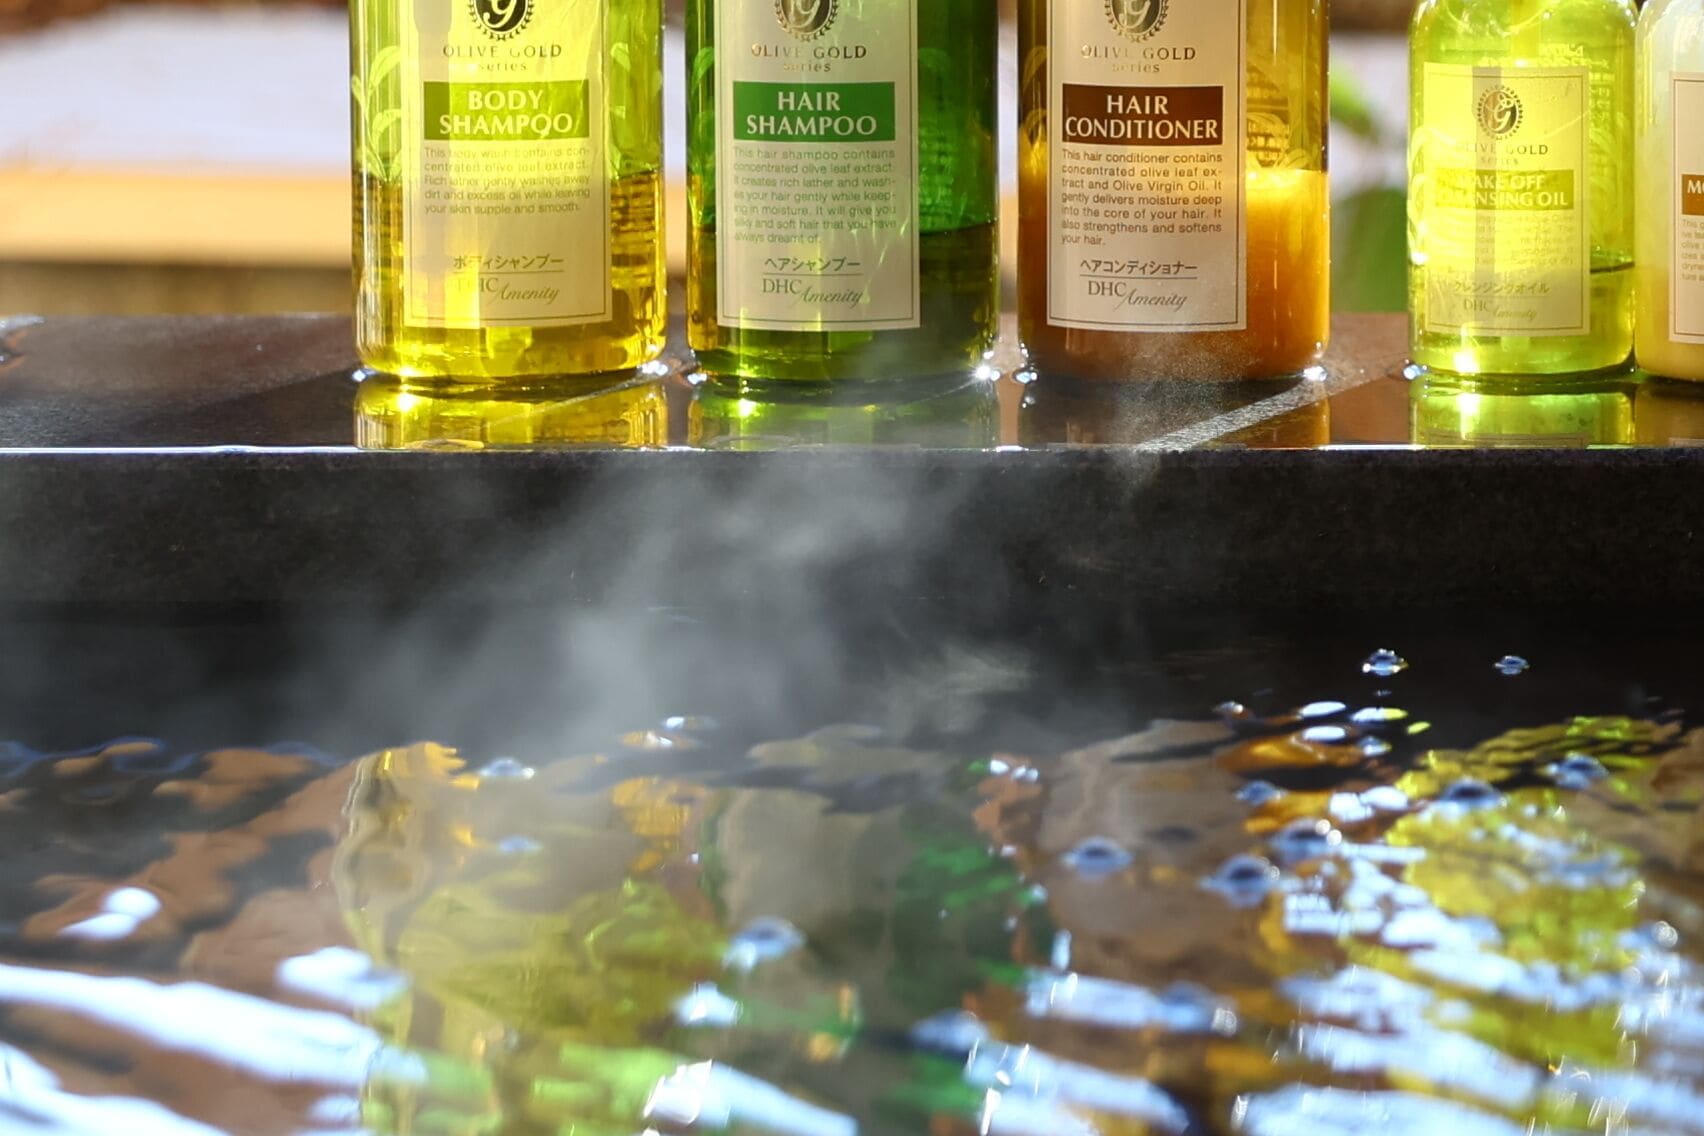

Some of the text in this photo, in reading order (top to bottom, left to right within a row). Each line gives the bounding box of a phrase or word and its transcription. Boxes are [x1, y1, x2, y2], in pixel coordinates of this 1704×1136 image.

[443, 44, 561, 57] OLIVE GOLD
[751, 44, 867, 59] OLIVE GOLD
[1143, 47, 1196, 60] GOLD
[783, 63, 831, 72] series
[468, 89, 544, 110] BODY
[778, 91, 841, 112] HAIR
[1107, 94, 1168, 115] HAIR
[439, 113, 573, 135] SHAMPOO
[746, 115, 877, 136] SHAMPOO
[1065, 116, 1218, 140] CONDITIONER
[734, 146, 896, 162] This hair shampoo contains
[1062, 148, 1222, 164] This hair conditioner contains
[734, 163, 851, 174] concentrated olive leaf
[1061, 164, 1222, 177] concentrated olive leaf ex-
[780, 178, 799, 188] rich
[803, 178, 833, 188] lather
[838, 178, 859, 188] and
[862, 177, 896, 188] wash-
[1061, 177, 1222, 193] tract and Olive Virgin Oil. It
[1510, 174, 1546, 190] OFF
[467, 192, 506, 201] excess
[746, 191, 767, 202] your
[771, 191, 790, 200] hair
[794, 191, 828, 204] gently
[832, 191, 861, 201] while
[1061, 192, 1222, 206] gently delivers moisture deep
[1537, 192, 1568, 207] OIL
[449, 204, 471, 214] skin
[474, 204, 511, 216] supple
[514, 203, 535, 213] and
[828, 206, 846, 215] will
[849, 206, 873, 218] give
[875, 206, 896, 217] you
[1062, 206, 1222, 221] into the core of your hair. It
[755, 219, 774, 229] and
[777, 219, 796, 229] soft
[800, 219, 819, 229] hair
[823, 219, 844, 229] that
[847, 220, 868, 231] you
[1062, 220, 1222, 234] also strengthens and softens
[767, 232, 804, 244] dreamt
[1061, 234, 1106, 246] your hair.
[1080, 259, 1199, 275] ヘアコンディショナー
[493, 282, 560, 305] Amenity
[762, 278, 864, 309] DHC Amenity
[1087, 280, 1188, 312] DHC Amenity
[1463, 299, 1493, 311] DHC
